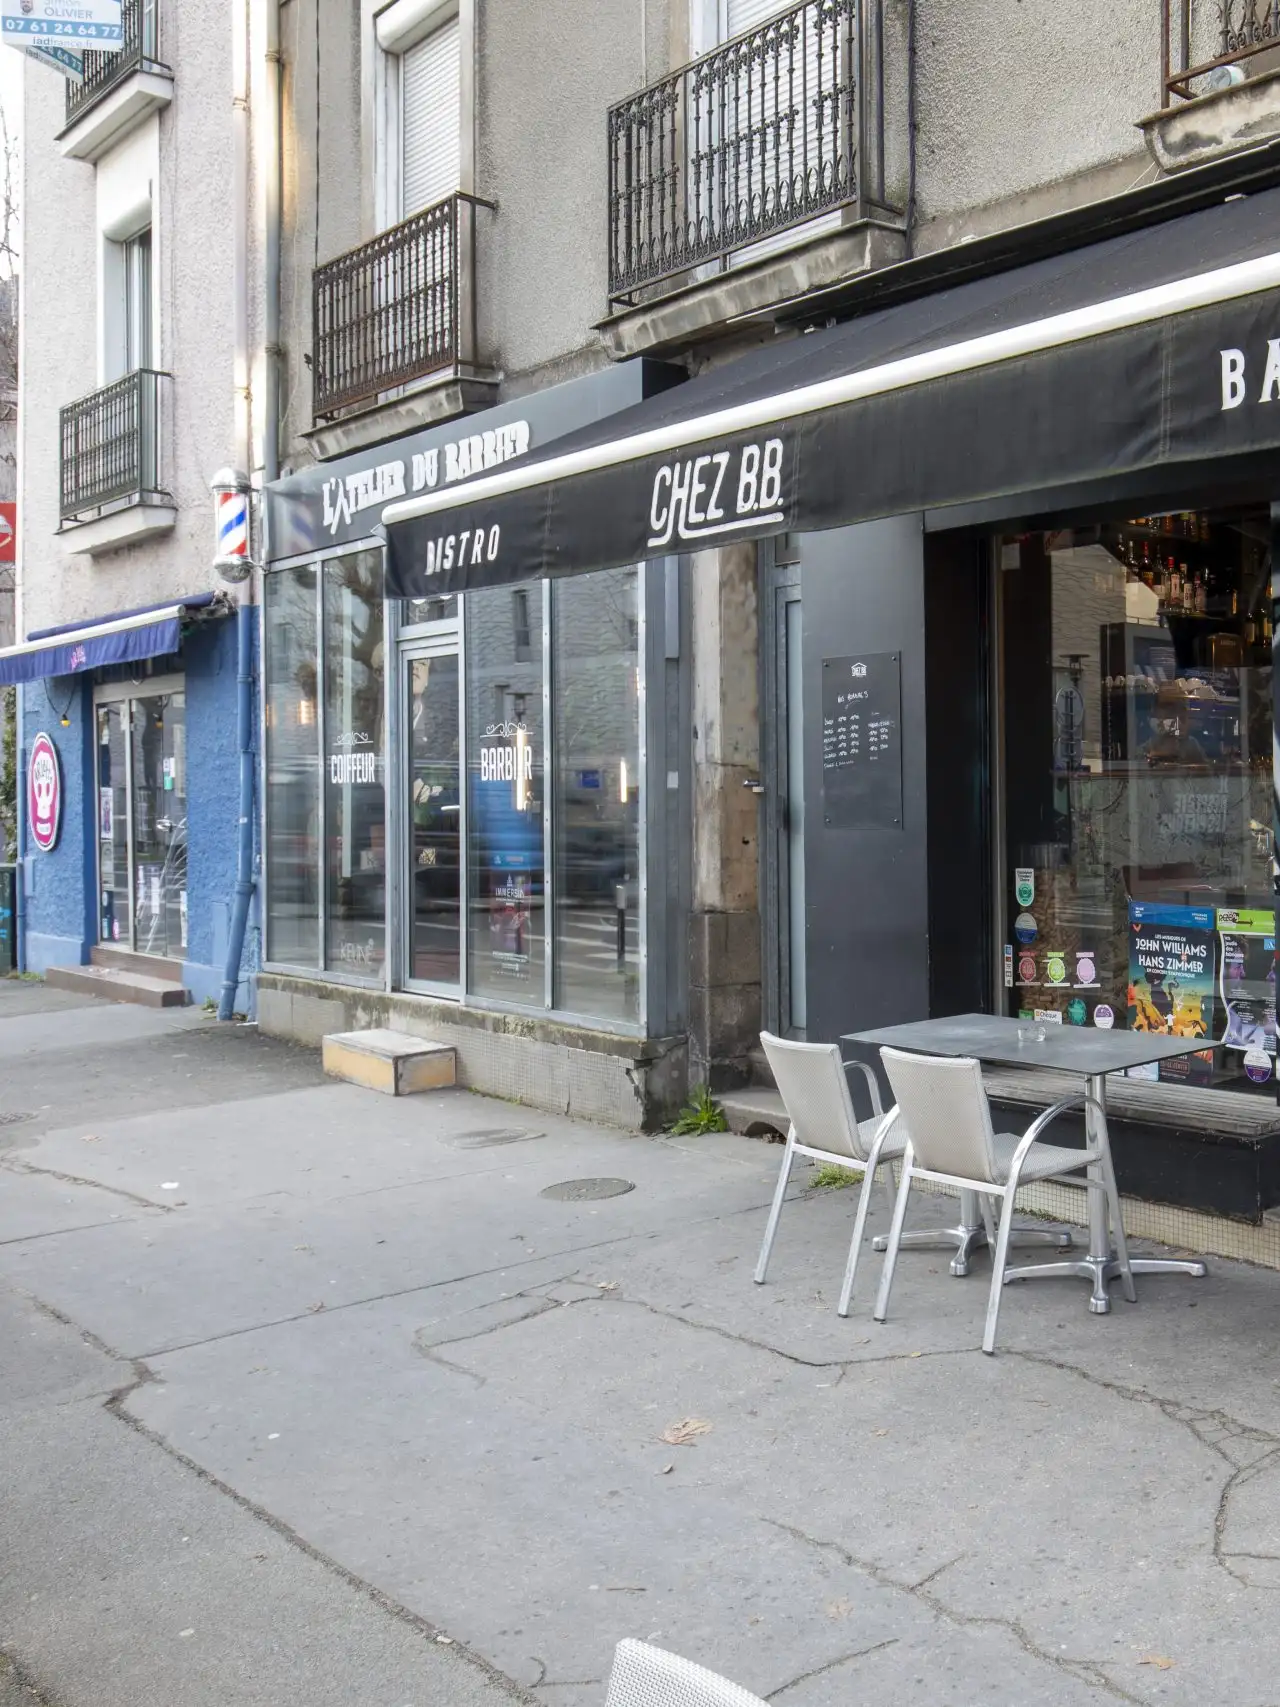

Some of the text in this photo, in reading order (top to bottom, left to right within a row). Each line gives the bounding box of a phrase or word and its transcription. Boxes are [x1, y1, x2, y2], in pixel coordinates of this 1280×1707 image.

[6, 19, 120, 37] 07 61 24 64 77
[44, 7, 93, 20] OLIVIER
[412, 449, 439, 492] DU
[445, 420, 530, 483] BARBIER
[648, 451, 731, 548] CHEZ
[424, 524, 500, 576] BISTRO
[331, 752, 375, 784] COIFFEUR
[480, 745, 533, 782] BARBIR
[1135, 938, 1207, 957] JOHN WILLIAMS
[1138, 954, 1204, 973] HANS ZIMMER
